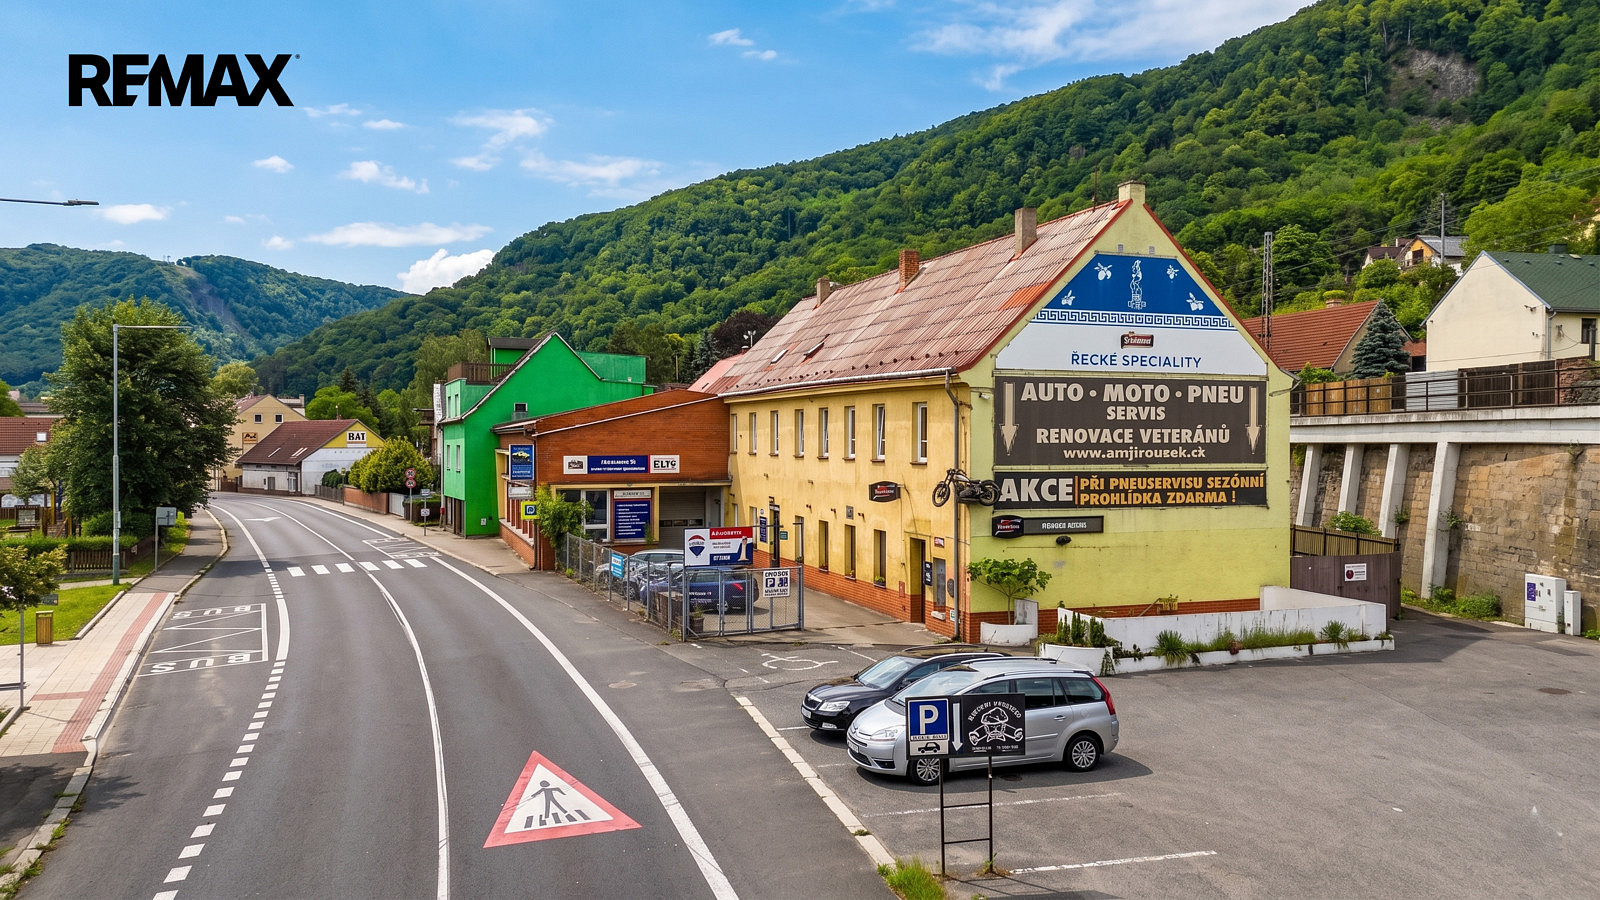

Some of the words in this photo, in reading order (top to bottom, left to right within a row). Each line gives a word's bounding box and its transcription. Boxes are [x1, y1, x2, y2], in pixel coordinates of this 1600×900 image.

[1071, 351, 1117, 366] ŘECKÉ
[1122, 354, 1202, 368] SPECIALITY
[1021, 382, 1084, 402] AUTO
[1103, 384, 1170, 403] MOTO
[1188, 385, 1244, 404] PNEU
[1106, 406, 1166, 420] SERVIS
[349, 432, 366, 440] BAT
[1036, 428, 1134, 444] RENOVACE
[1139, 424, 1230, 444] VETERÁNŮ
[999, 478, 1073, 502] AKCE
[1080, 475, 1105, 490] PŘI
[1110, 475, 1203, 490] PNEUSERVISU
[1207, 472, 1265, 488] SEZÓNNÍ
[1080, 490, 1162, 505] PROHLÍDKA
[1166, 492, 1227, 504] ZDARMA
[1231, 490, 1236, 503] !
[919, 704, 938, 734] P
